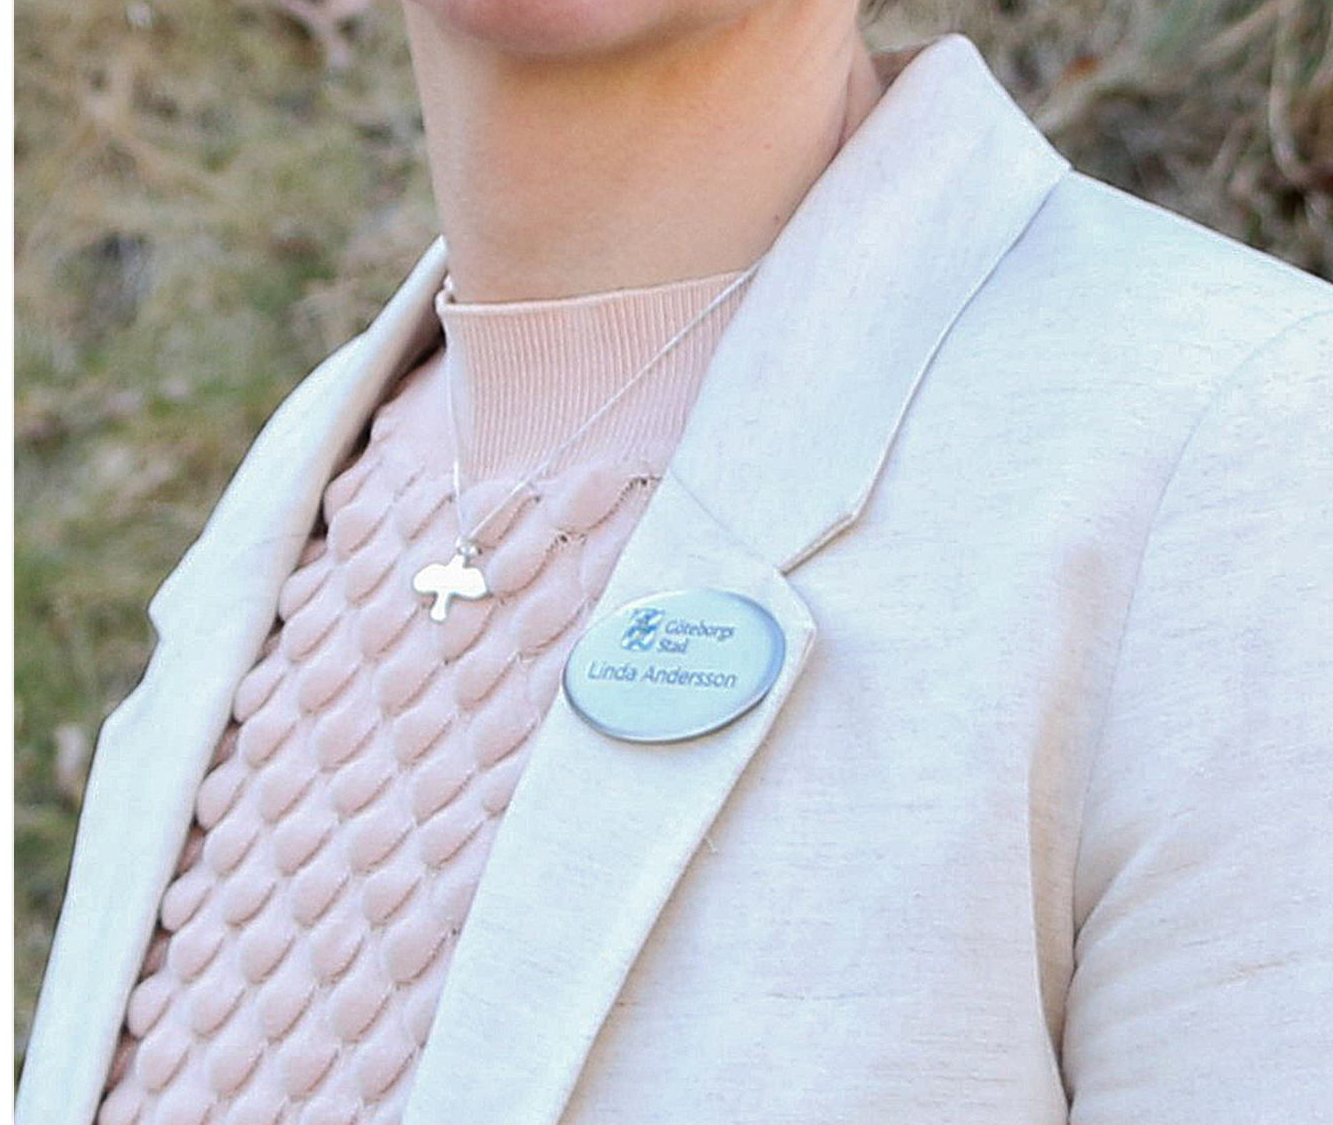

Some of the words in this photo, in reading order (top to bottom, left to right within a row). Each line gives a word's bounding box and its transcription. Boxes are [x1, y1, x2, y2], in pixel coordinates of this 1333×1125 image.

[664, 619, 735, 642] Göteborgs
[656, 638, 689, 654] Stad
[587, 660, 637, 683] Linda
[640, 664, 737, 690] Andersson
